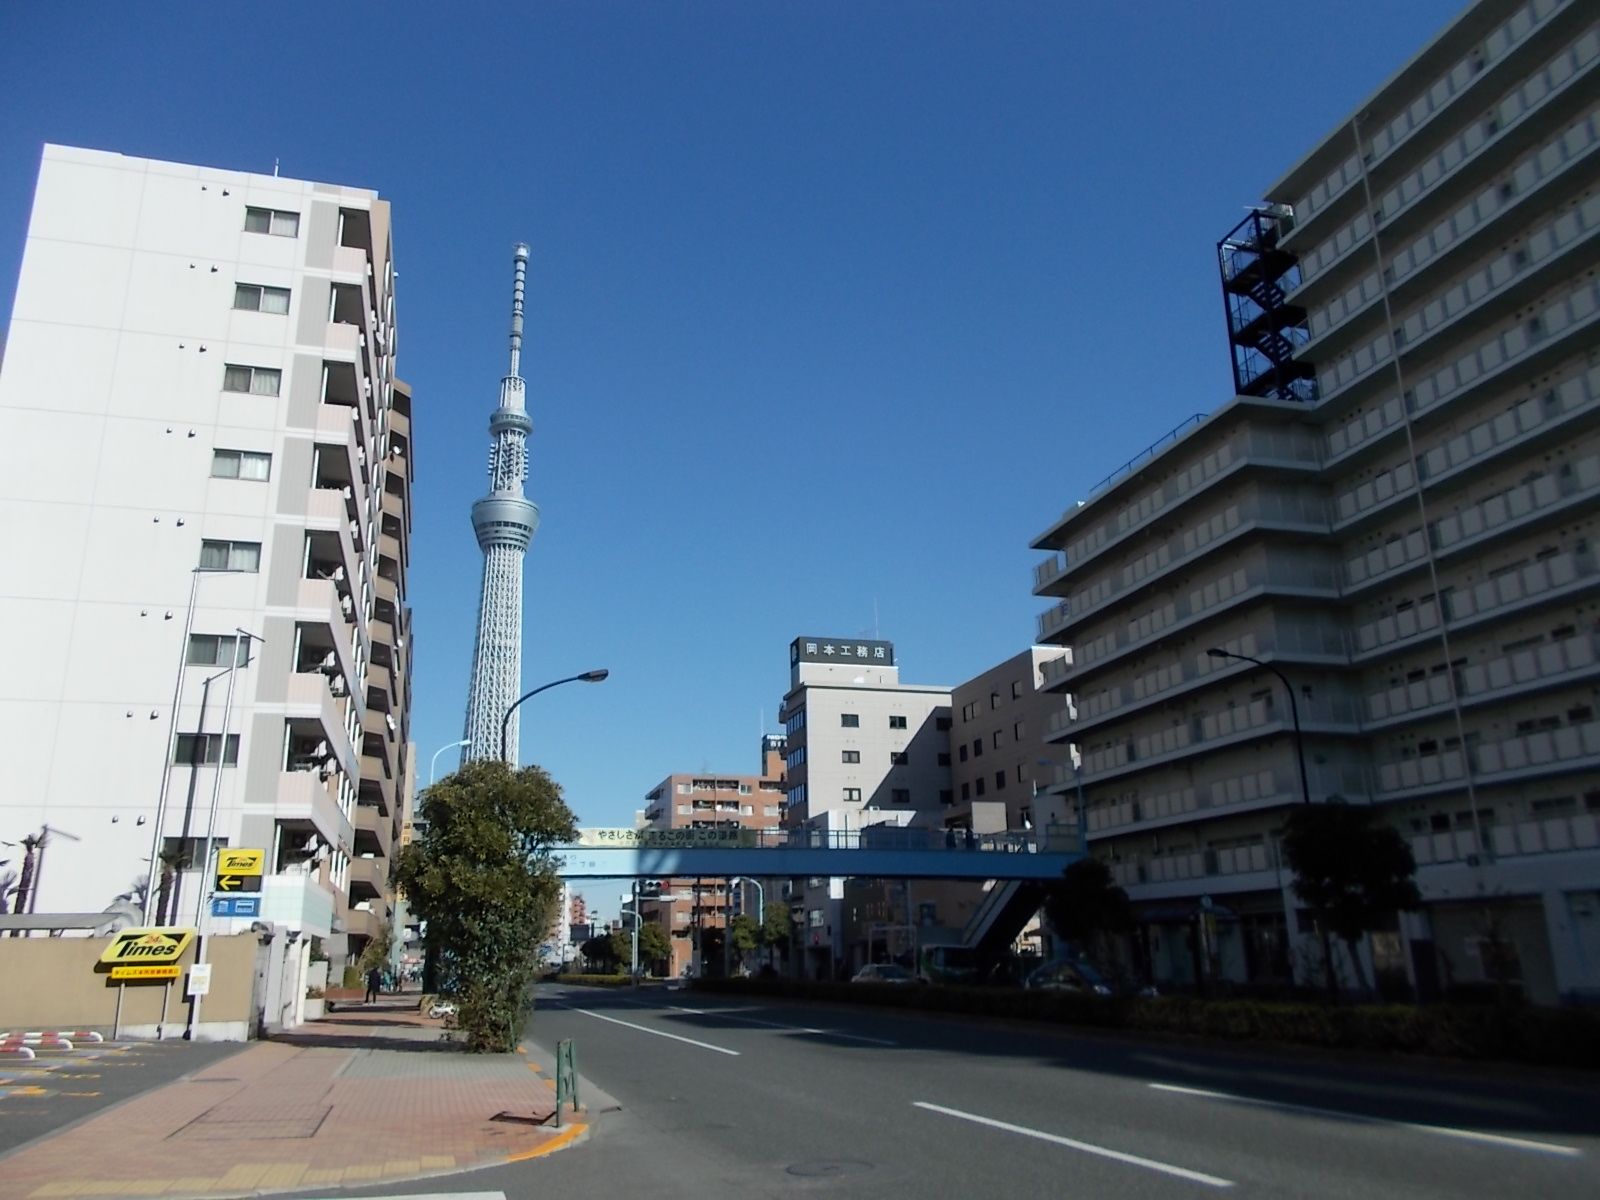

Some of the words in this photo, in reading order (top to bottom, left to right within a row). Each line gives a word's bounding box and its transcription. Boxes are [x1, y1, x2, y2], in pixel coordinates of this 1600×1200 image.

[806, 643, 885, 658] 岡本工務店
[226, 857, 255, 868] Times
[116, 935, 178, 958] Times
